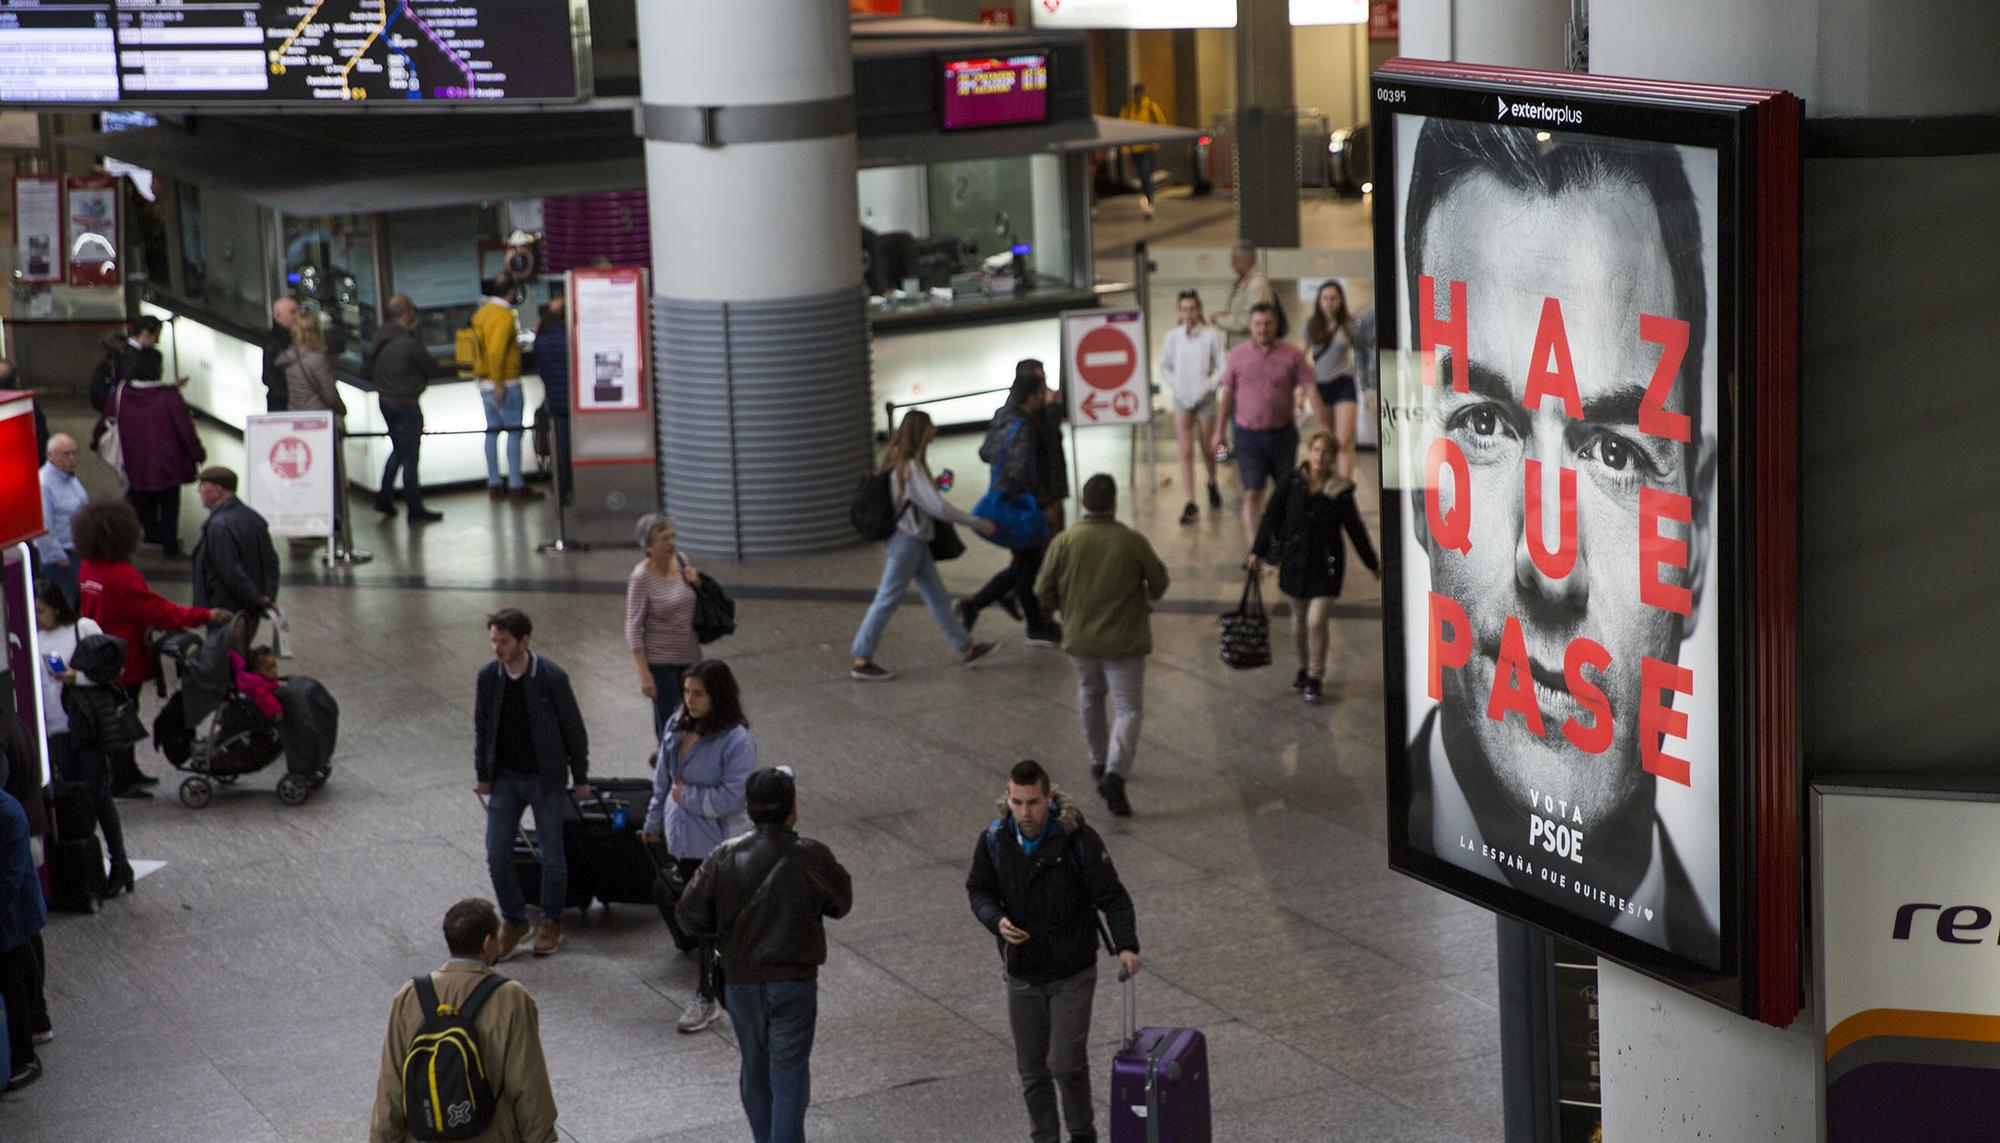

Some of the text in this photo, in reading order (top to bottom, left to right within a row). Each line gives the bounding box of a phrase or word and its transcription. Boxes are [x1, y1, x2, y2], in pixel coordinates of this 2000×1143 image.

[1377, 88, 1406, 103] 00395
[1511, 102, 1583, 125] exteriorplus
[1418, 273, 1692, 443] HAZ
[1424, 437, 1693, 617] QUE
[1427, 591, 1694, 787] PASE
[1530, 789, 1583, 825] VOTA
[1459, 835, 1475, 852] LA
[1482, 844, 1533, 875] ESPAÑA
[1541, 868, 1566, 888] QUE
[1529, 814, 1584, 864] PSOE
[1892, 903, 2000, 946] re
